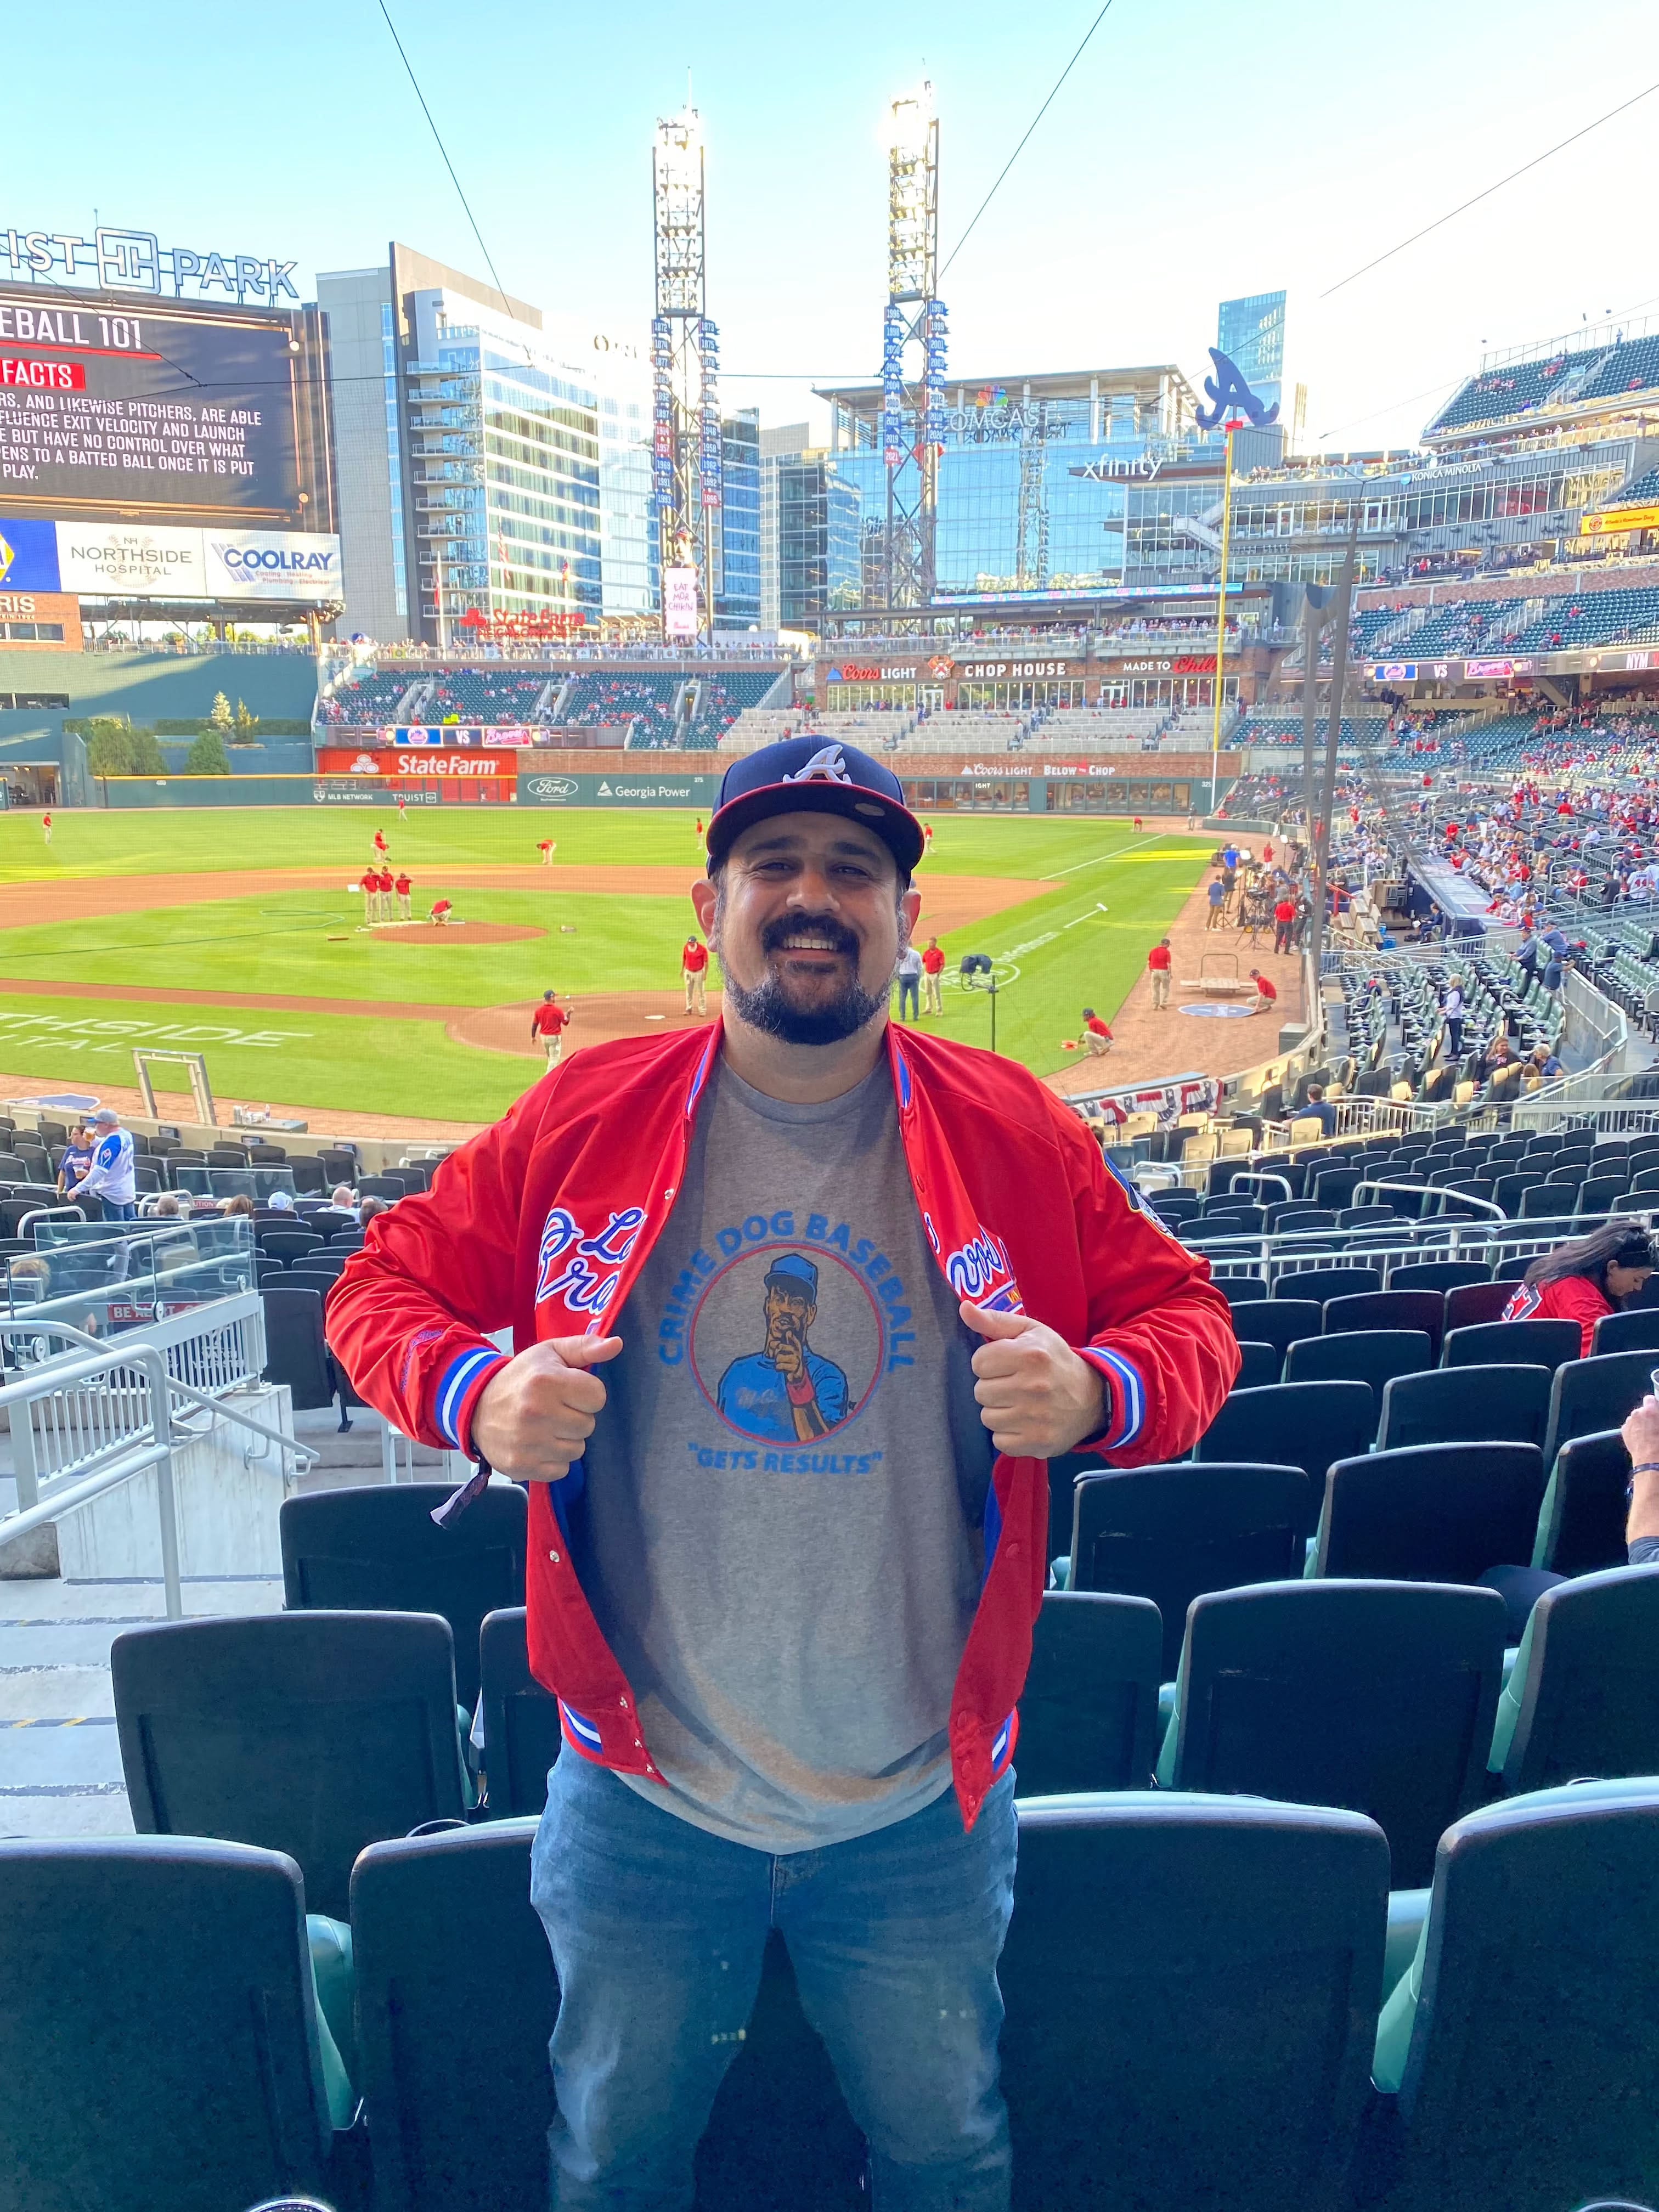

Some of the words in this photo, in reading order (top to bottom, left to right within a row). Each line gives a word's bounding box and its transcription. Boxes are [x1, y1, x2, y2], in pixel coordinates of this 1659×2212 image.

[172, 247, 300, 299] PARK
[887, 309, 900, 318] 1996
[931, 303, 944, 313] 1997
[98, 316, 142, 349] 101
[701, 321, 714, 332] 1873
[931, 321, 944, 331] 1999
[931, 340, 944, 349] 2001
[655, 357, 668, 366] 1877
[930, 357, 944, 367] 2003
[2, 359, 72, 388] FACTS
[886, 380, 900, 390] 2004
[26, 394, 54, 410] AND
[59, 396, 124, 416] LIKEWISE
[128, 402, 196, 422] PITCHERS,
[201, 408, 227, 423] ARE
[230, 410, 262, 426] ABLE
[656, 409, 669, 419] 1897
[886, 416, 899, 425] 2013
[930, 412, 943, 422] 2018
[949, 407, 1049, 432] OMCAST
[63, 415, 92, 431] EXIT
[95, 417, 157, 435] VELOCITY
[162, 422, 189, 437] AND
[194, 424, 245, 441] LAUNCH
[930, 430, 943, 439] 2020
[12, 428, 38, 444] BUT
[43, 431, 79, 447] HAVE
[83, 433, 102, 449] NO
[107, 435, 168, 453] CONTROL
[171, 439, 205, 455] OVER
[208, 442, 246, 458] WHAT
[886, 434, 899, 443] 2019
[657, 442, 670, 453] 1957
[0, 445, 29, 461] ENS
[32, 447, 50, 462] TO
[55, 449, 65, 464] A
[69, 450, 117, 467] BATTED
[122, 453, 155, 470] BALL
[158, 456, 194, 472] ONCE
[198, 459, 209, 473] IT
[213, 459, 226, 473] IS
[230, 460, 255, 476] PUT
[885, 452, 898, 461] 2021
[3, 463, 39, 479] PLAY.
[657, 459, 670, 470] 1969
[1082, 452, 1163, 483] xfinity
[1411, 469, 1443, 482] KONICA
[1444, 463, 1481, 477] MINOLTA
[658, 477, 670, 487] 1991
[658, 494, 672, 504] 1993
[123, 537, 138, 545] NH
[71, 546, 193, 564] NORTHSIDE
[223, 548, 334, 571] COOLRAY
[95, 563, 172, 575] HOSPITAL
[674, 582, 689, 591] EAT
[673, 592, 690, 601] MOR
[1123, 661, 1154, 672] MADE
[1156, 661, 1171, 670] TO
[1173, 654, 1217, 674] Chill
[1626, 652, 1649, 669] NYM
[842, 663, 881, 681] Coors
[881, 667, 917, 680] LIGHT
[964, 663, 1007, 677] CHOP
[1013, 662, 1066, 676] HOUSE
[1434, 664, 1448, 678] VS
[456, 730, 471, 744] VS
[973, 763, 1003, 775] Coors
[1005, 767, 1033, 776] LIGHT
[537, 779, 569, 794] Ford
[615, 786, 656, 799] Georgia
[659, 786, 691, 797] Power
[658, 1248, 717, 1367] CRIME
[715, 1210, 795, 1257] DOG
[805, 1212, 917, 1373] BASEBALL
[763, 1450, 884, 1475] RESULTS"
